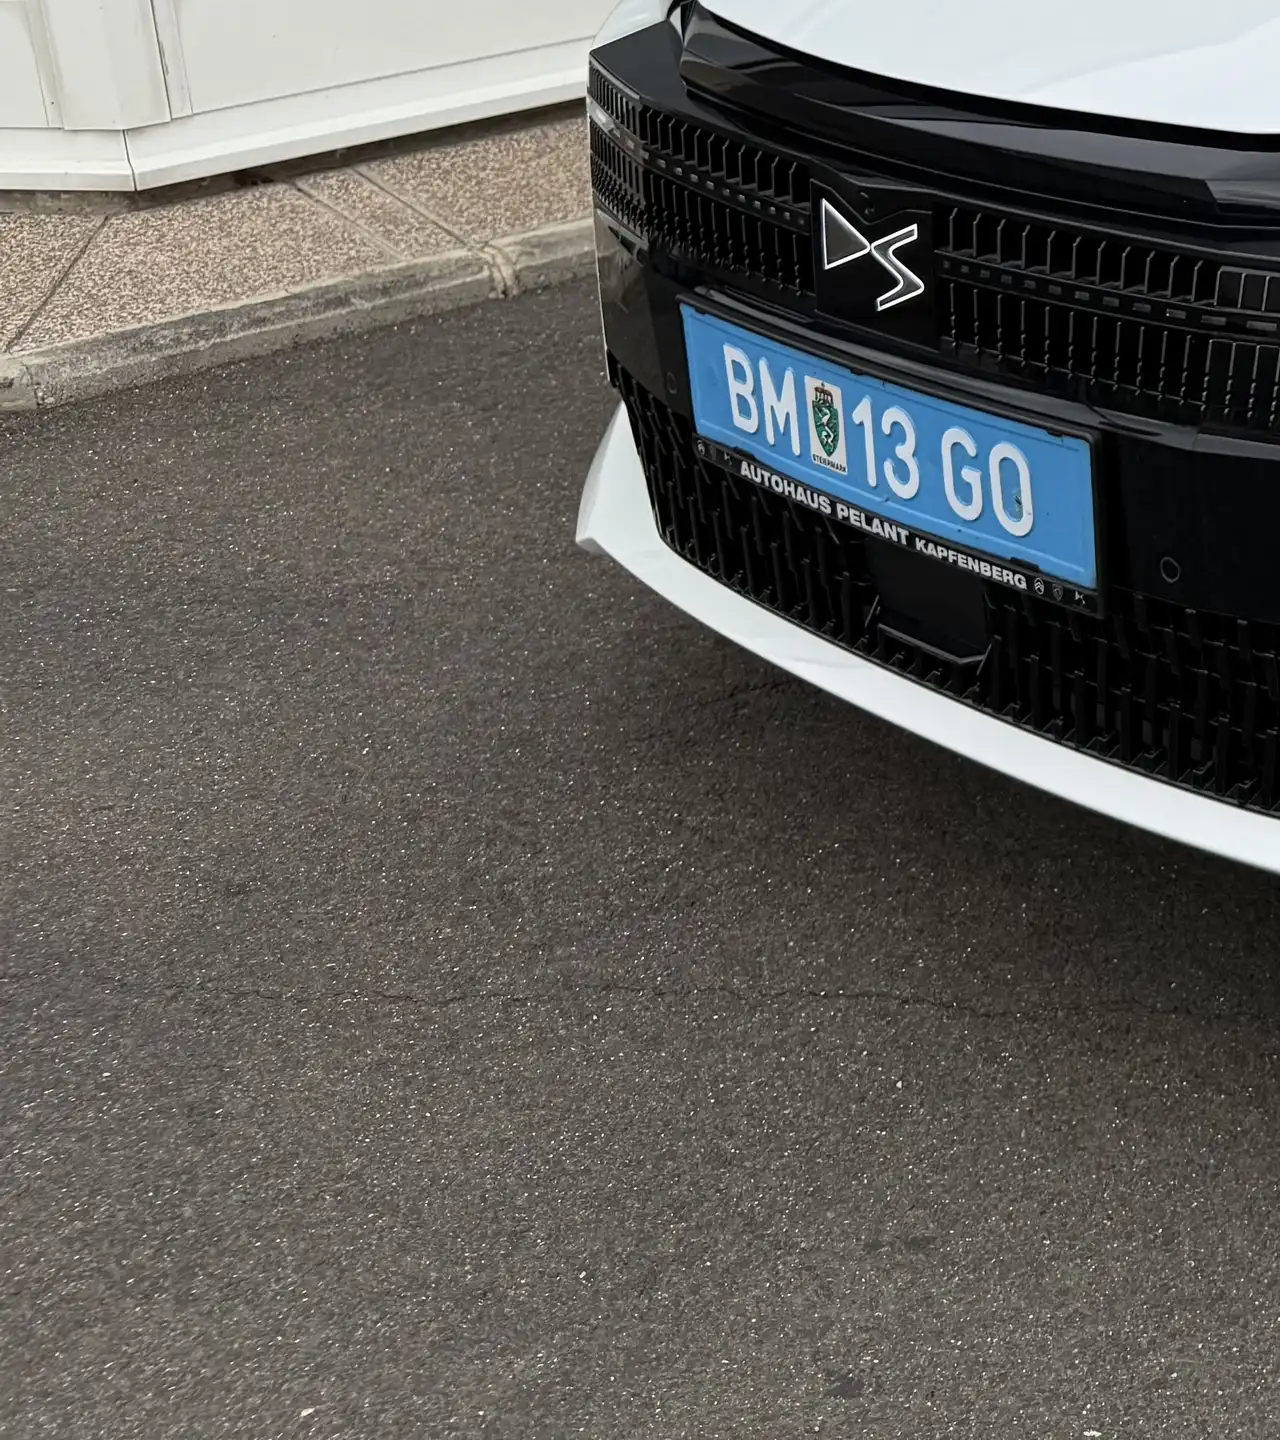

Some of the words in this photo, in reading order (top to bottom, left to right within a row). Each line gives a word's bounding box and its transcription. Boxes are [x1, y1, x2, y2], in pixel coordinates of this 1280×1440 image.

[722, 342, 800, 457] BM
[852, 395, 920, 500] 13
[941, 426, 1034, 537] GO
[740, 461, 832, 515] AUTOHAUS
[836, 502, 910, 546] PELANT
[915, 535, 1028, 590] KAPFENBERG
